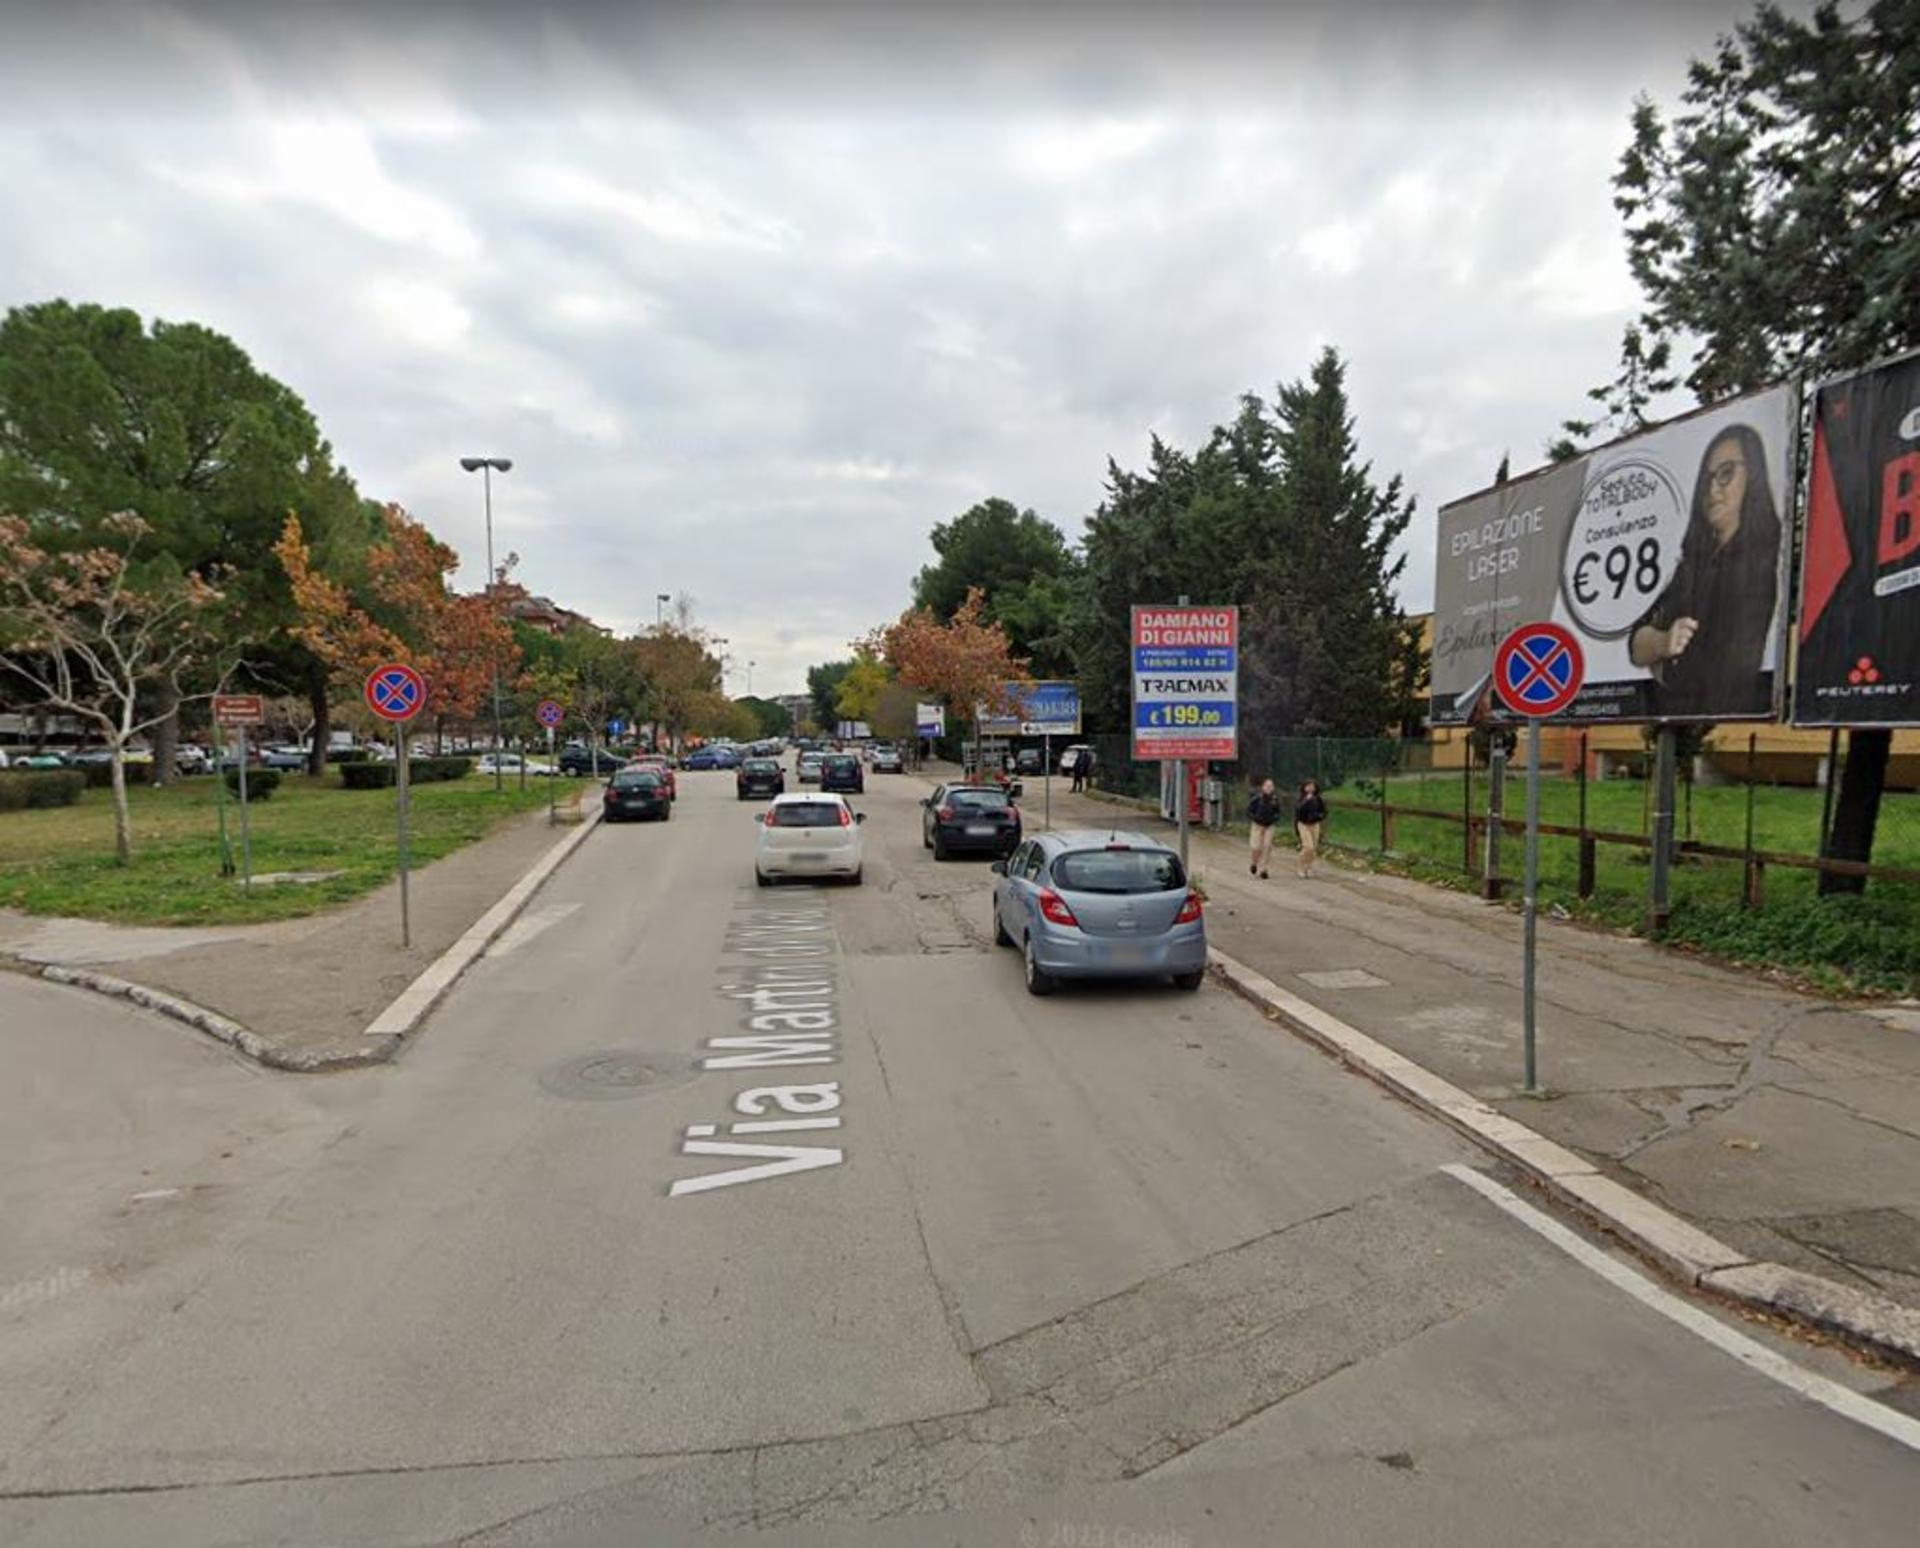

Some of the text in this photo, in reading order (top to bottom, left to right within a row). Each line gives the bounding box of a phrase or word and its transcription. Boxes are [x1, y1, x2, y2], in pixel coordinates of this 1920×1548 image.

[1452, 506, 1544, 556] EPILAZIONE
[1586, 515, 1657, 543] Consulenza
[1468, 547, 1519, 581] LASER
[1141, 613, 1228, 628] DAMIANO
[1141, 629, 1229, 645] DI GIANNI
[1142, 679, 1227, 693] TRACMAX
[1816, 682, 1911, 697] PEUTEREY
